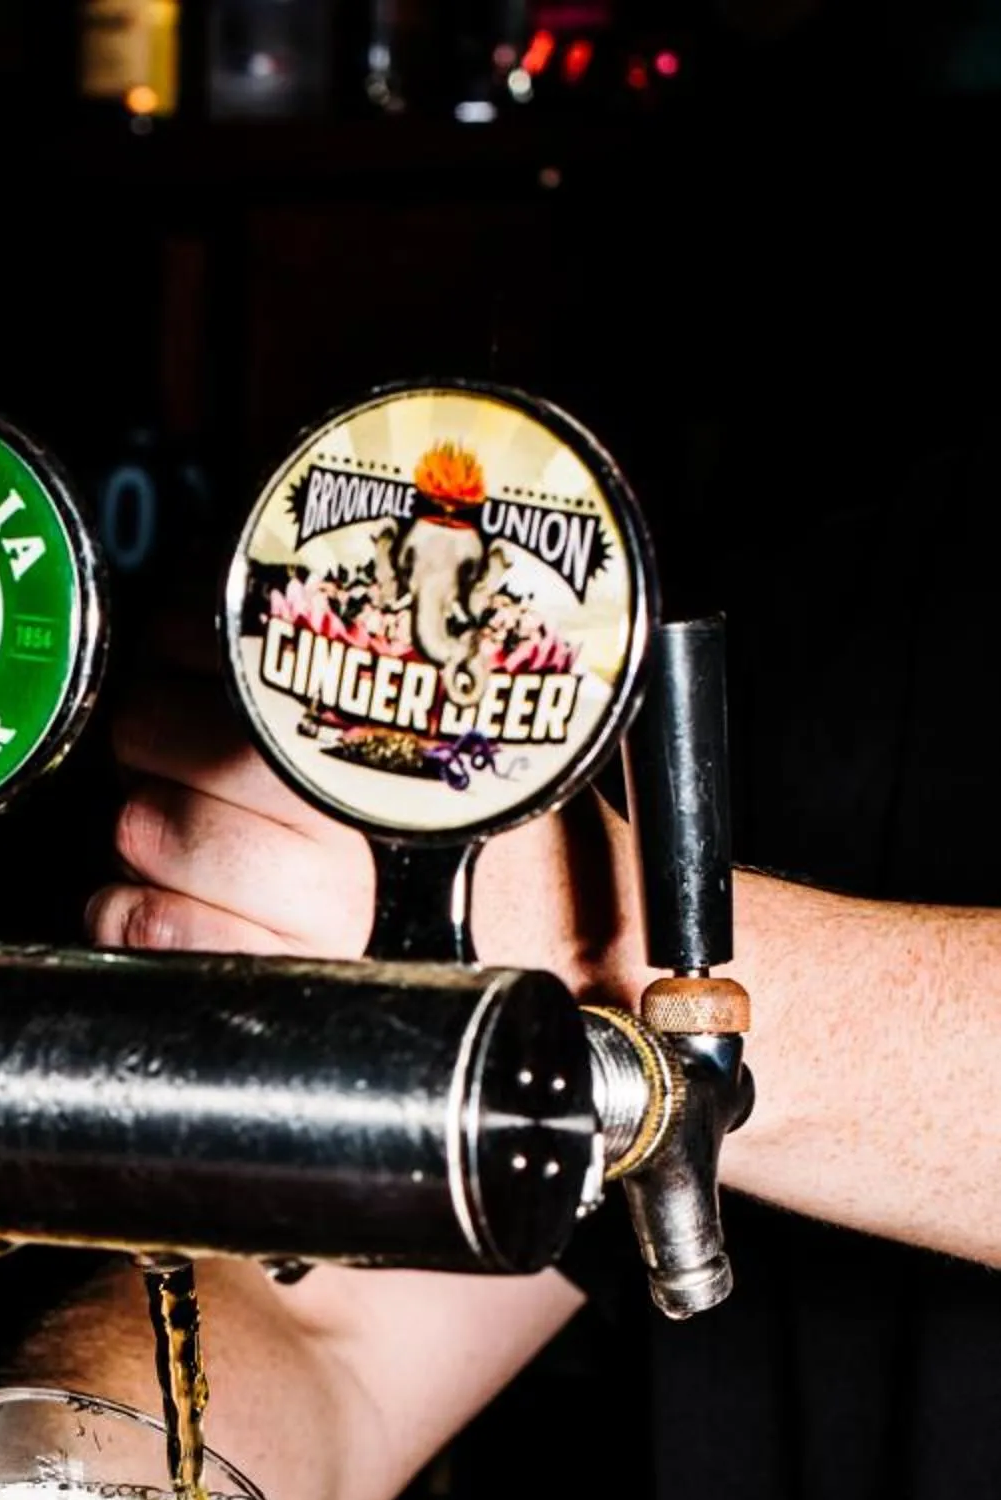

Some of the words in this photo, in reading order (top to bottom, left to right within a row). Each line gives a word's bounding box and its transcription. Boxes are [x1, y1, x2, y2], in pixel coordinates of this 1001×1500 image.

[301, 470, 417, 539] BROOKVALE
[481, 502, 597, 592] UNION
[263, 617, 437, 730] GINGER
